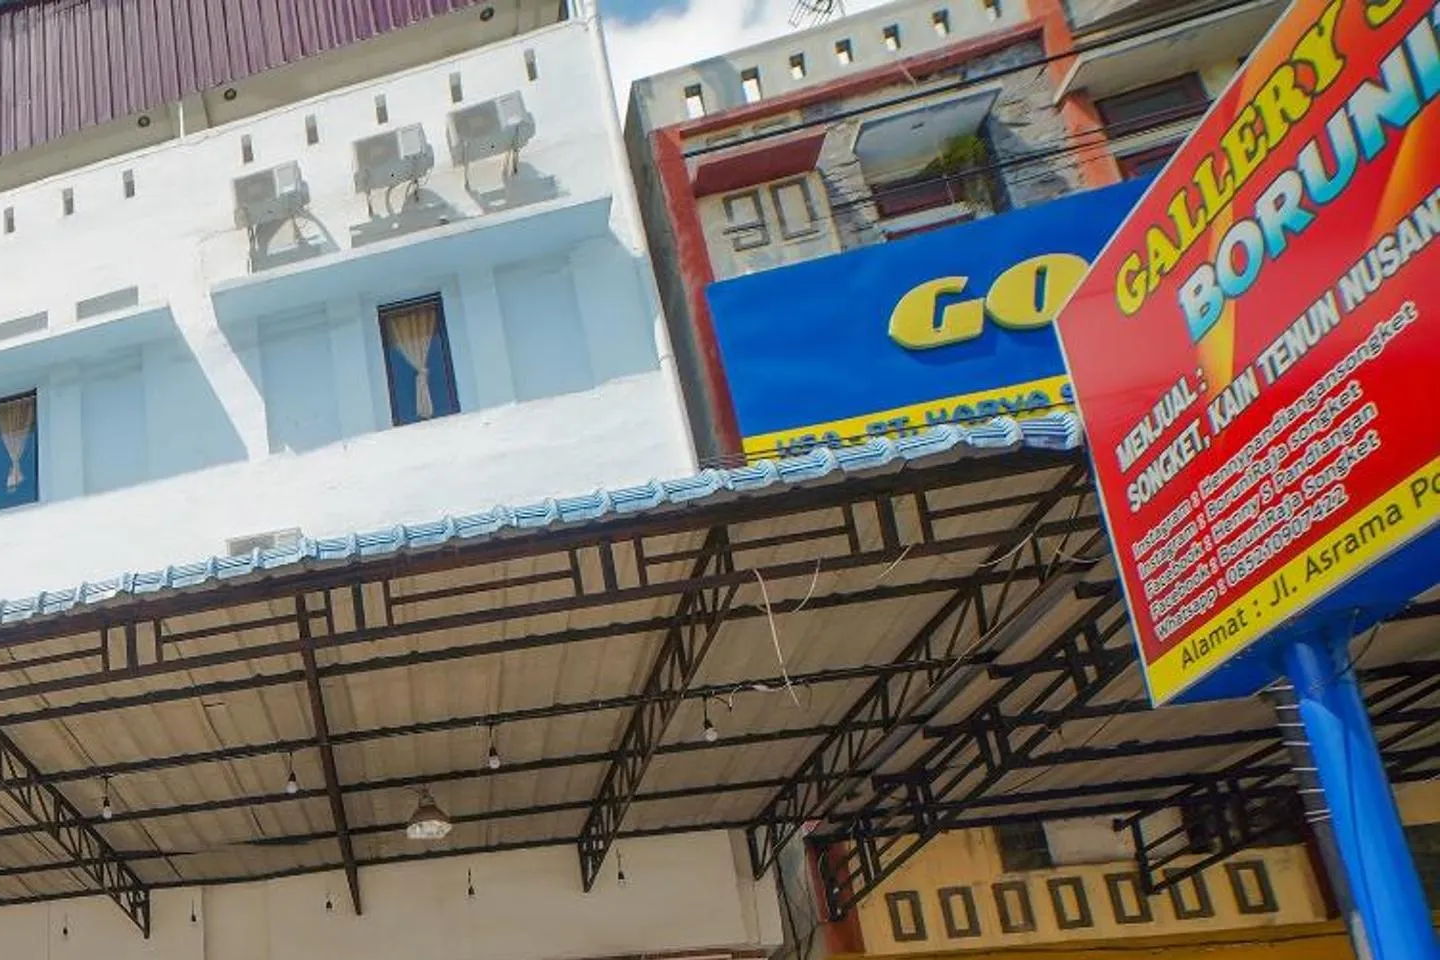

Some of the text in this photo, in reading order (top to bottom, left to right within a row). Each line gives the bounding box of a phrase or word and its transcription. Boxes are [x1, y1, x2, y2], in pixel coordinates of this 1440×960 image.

[1116, 0, 1346, 317] GALLERY
[1177, 0, 1440, 344] BORUNI
[889, 253, 1091, 350] GO
[1115, 376, 1197, 473] MENJUAL
[1127, 417, 1210, 512] SONGKET,
[1207, 365, 1259, 435] KAIN
[1256, 290, 1340, 386] TENUN
[1132, 498, 1193, 560] Instagram
[1137, 521, 1197, 580] Instagram
[1211, 493, 1260, 543] Henny
[1260, 481, 1273, 505] S
[1181, 609, 1248, 669] Alamat
[1270, 573, 1297, 607] Jl.
[1305, 503, 1403, 583] Asrama
